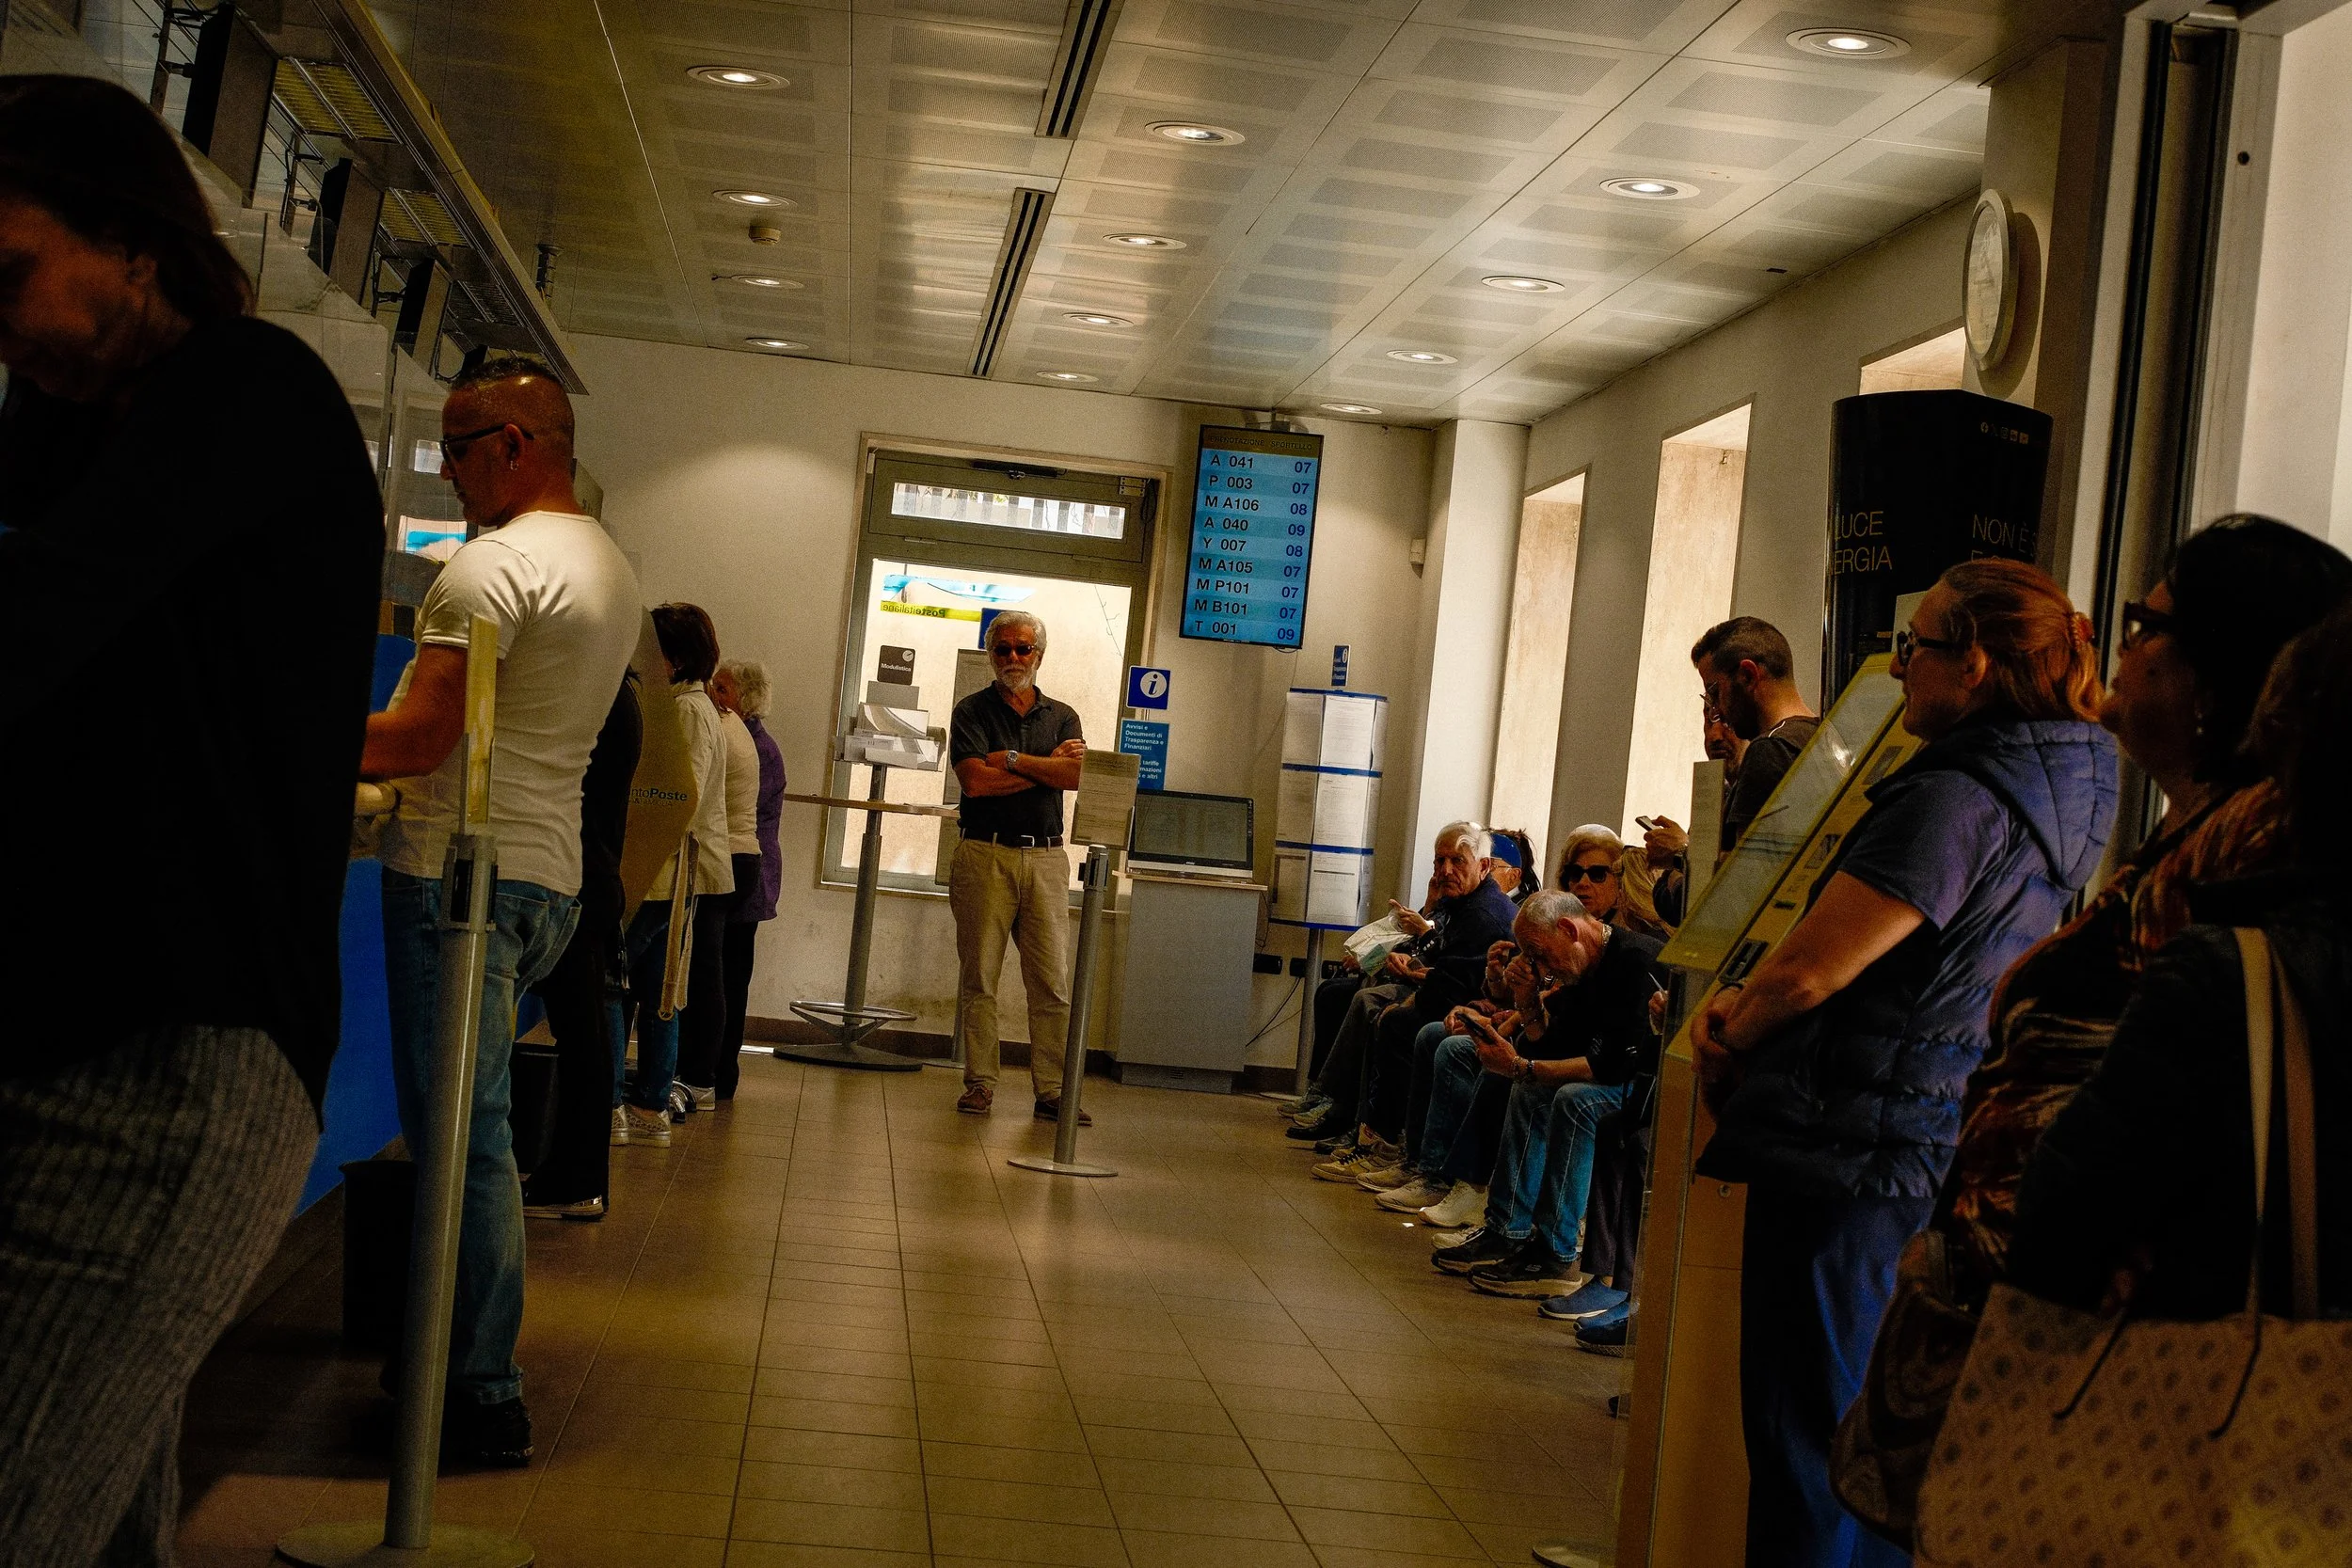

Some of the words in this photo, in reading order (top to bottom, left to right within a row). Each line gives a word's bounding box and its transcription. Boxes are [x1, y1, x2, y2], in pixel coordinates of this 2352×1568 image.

[1210, 436, 1265, 447] PRENOTAZIONE
[1271, 441, 1312, 451] SPORTELLO
[1211, 454, 1221, 467] A
[1229, 455, 1253, 468] 041
[1295, 461, 1311, 474] 07
[1209, 475, 1218, 486] P
[1227, 476, 1253, 489] 003
[1292, 483, 1310, 495] 07
[1204, 495, 1217, 508] M
[1223, 497, 1259, 511] A106
[1290, 503, 1307, 515] 08
[1203, 516, 1215, 529] A
[1222, 518, 1248, 531] 040
[1288, 524, 1305, 536] 09
[1972, 514, 2015, 549] NON
[1203, 537, 1213, 549] Y
[1220, 539, 1247, 552] 007
[1285, 545, 1303, 557] 08
[1199, 557, 1212, 570] M
[1216, 558, 1253, 574] A105
[1283, 565, 1301, 578] 07
[1196, 578, 1210, 591] M
[1215, 579, 1249, 594] P101
[1281, 586, 1299, 598] 07
[1194, 598, 1207, 611] M
[1212, 600, 1248, 615] B101
[1279, 607, 1297, 620] 07
[1195, 620, 1203, 632] T
[1212, 622, 1237, 635] 001
[1277, 627, 1295, 641] 09
[1125, 730, 1156, 738] Documenti
[1125, 736, 1159, 745] Trasparenza
